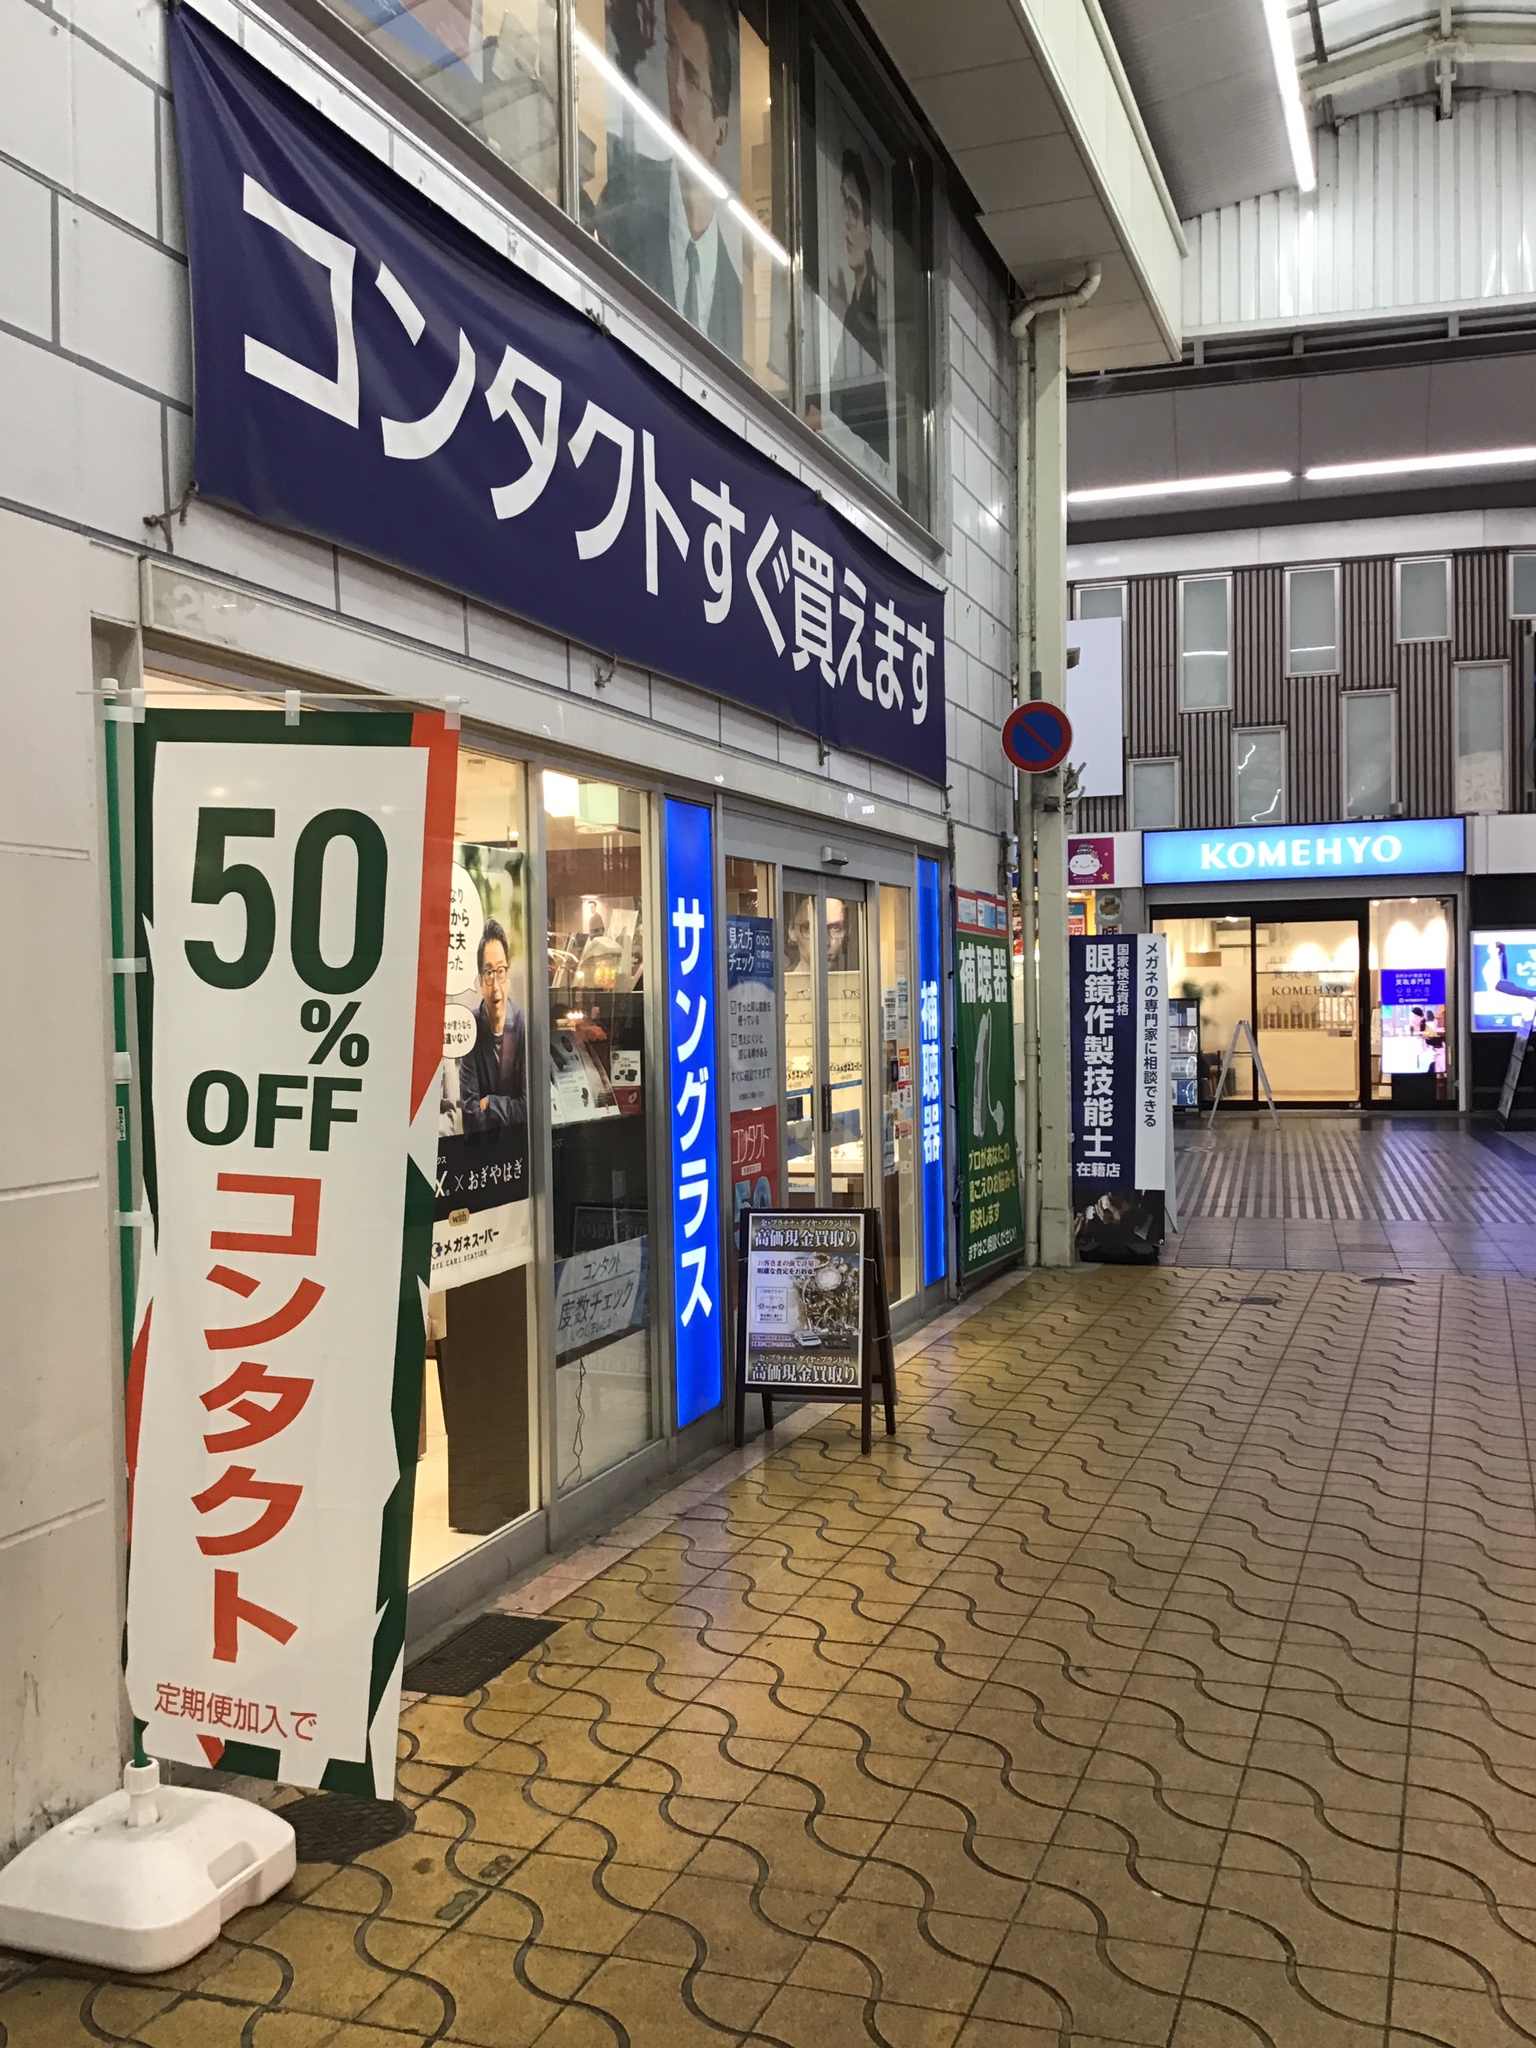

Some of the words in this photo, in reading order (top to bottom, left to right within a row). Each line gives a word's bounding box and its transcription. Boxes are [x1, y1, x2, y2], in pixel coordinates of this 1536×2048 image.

[243, 173, 935, 725] コンタクトすぐ買えます
[1200, 835, 1403, 870] KOMEHYO
[728, 927, 754, 950] 見え方
[728, 952, 755, 973] チェック
[959, 942, 1008, 1004] 補聴器
[1116, 944, 1130, 1016] 国家検定資格
[1271, 985, 1344, 996] KOMEHYO
[1083, 944, 1115, 1158] 眼鏡作製技能士
[1143, 942, 1159, 1128] メガネの専門家に相談できる
[920, 981, 941, 1165] 補聴器
[186, 1069, 363, 1152] OFF
[672, 897, 713, 1327] サングラス
[732, 1122, 769, 1164] コンタクト
[468, 1158, 523, 1191] おぎやはぎ
[1076, 1162, 1121, 1178] 在籍店
[452, 1211, 467, 1223] with
[755, 1229, 857, 1247] 高価現金買取り
[583, 1252, 622, 1281] コンタクト
[558, 1279, 634, 1331] 度数チェック
[752, 1363, 855, 1383] 高価現金買取り
[191, 1172, 326, 1663] コンタクト
[153, 1682, 318, 1741] 定期便加入で
